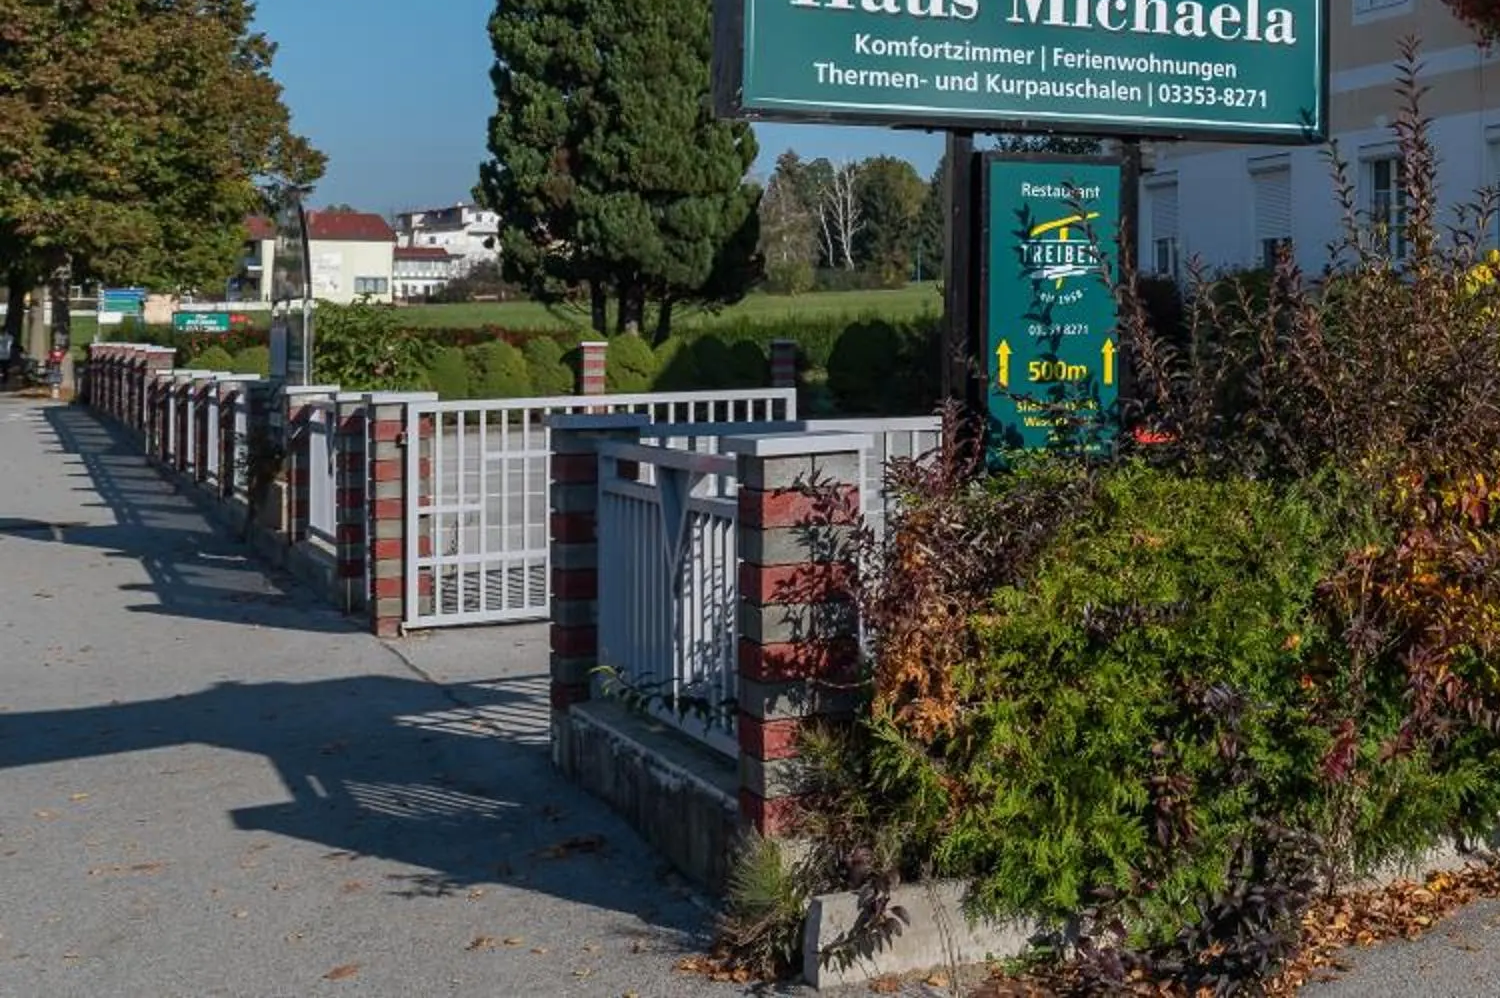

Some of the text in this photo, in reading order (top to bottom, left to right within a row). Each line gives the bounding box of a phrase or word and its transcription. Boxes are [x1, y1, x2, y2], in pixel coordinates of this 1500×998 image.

[854, 33, 1238, 81] Komfortzimmer Ferienwohnungen
[813, 61, 1268, 109] Thermen- und Kurpauschalen 03353-8271
[1020, 181, 1101, 199] Restauant
[1028, 361, 1088, 382] 500m
